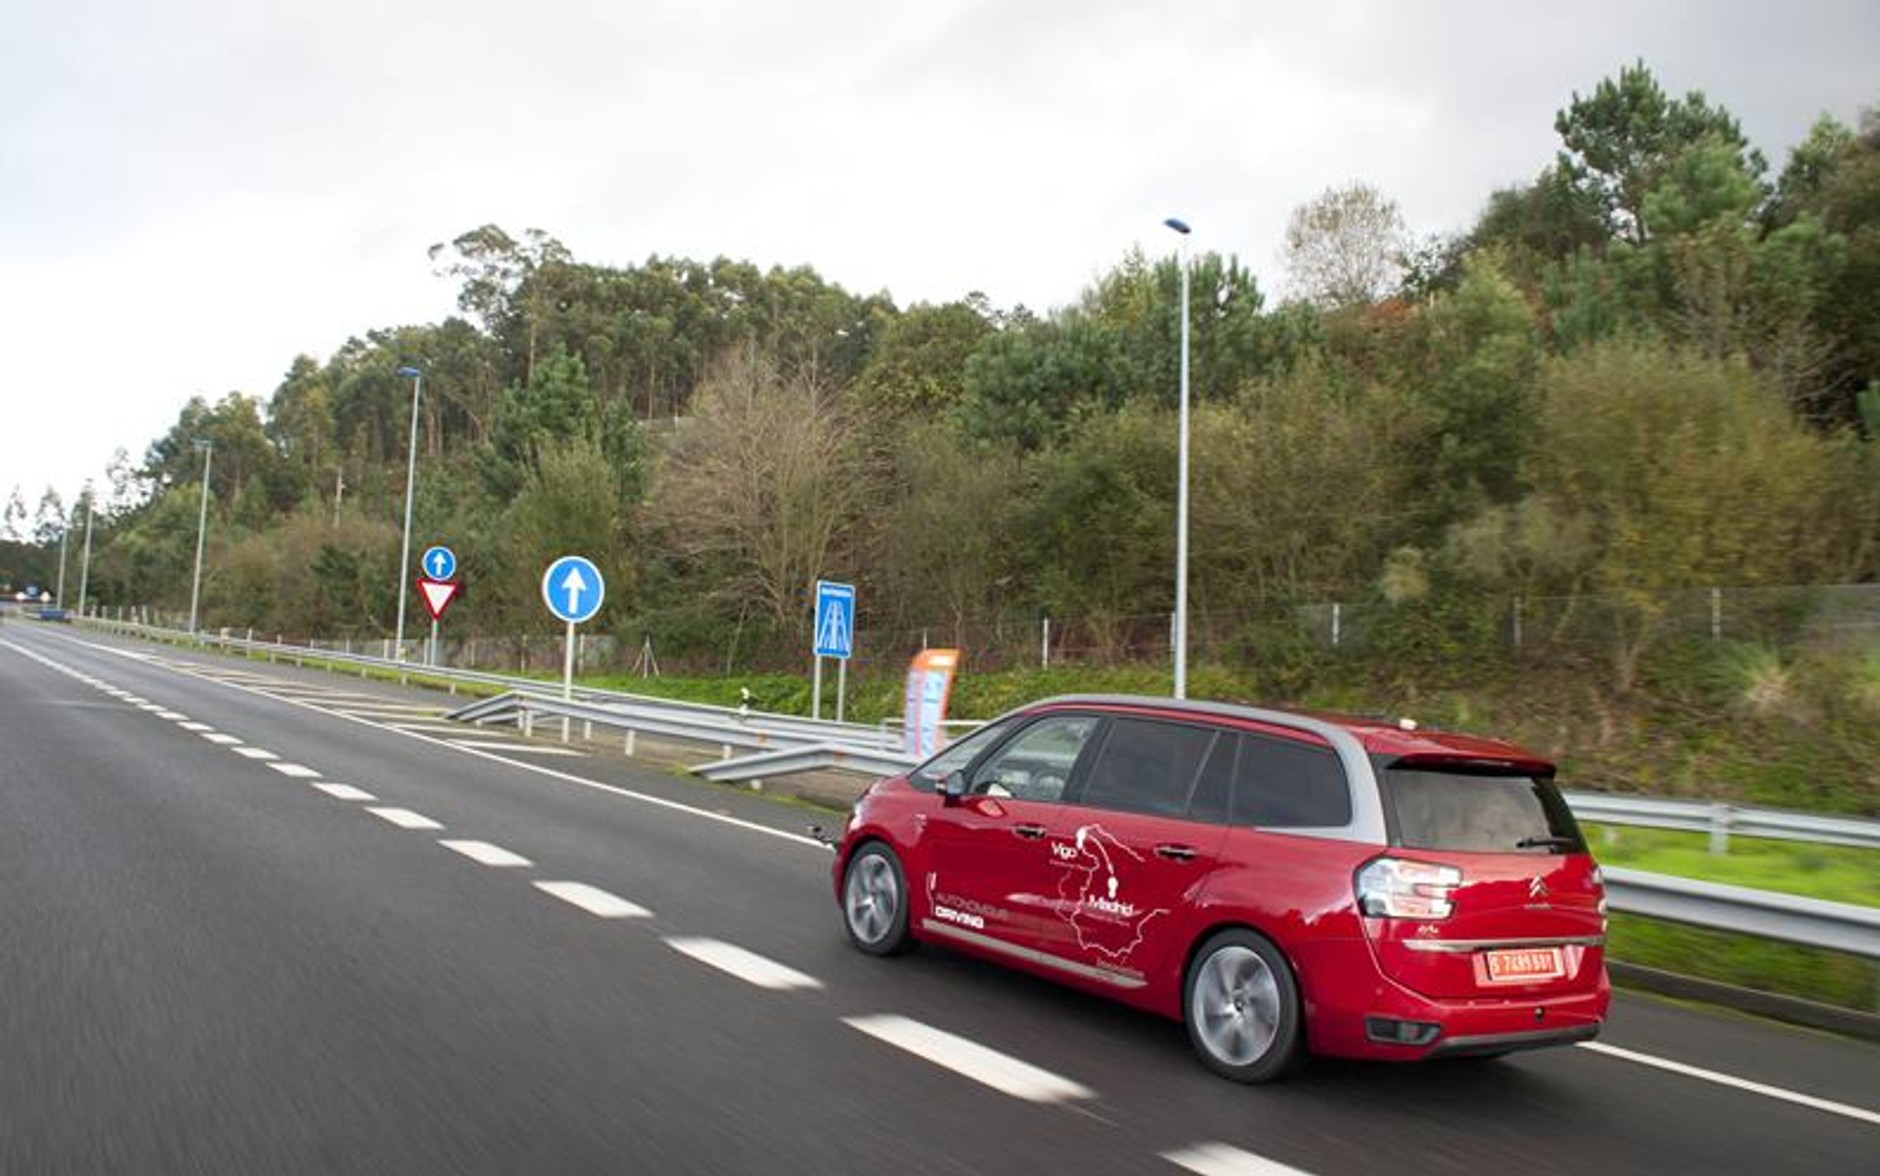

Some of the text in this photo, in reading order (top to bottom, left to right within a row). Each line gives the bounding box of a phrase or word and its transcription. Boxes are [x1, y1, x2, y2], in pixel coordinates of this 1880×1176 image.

[1051, 841, 1078, 860] Vigo
[934, 905, 985, 929] DRIVING
[1088, 894, 1134, 917] Madrid
